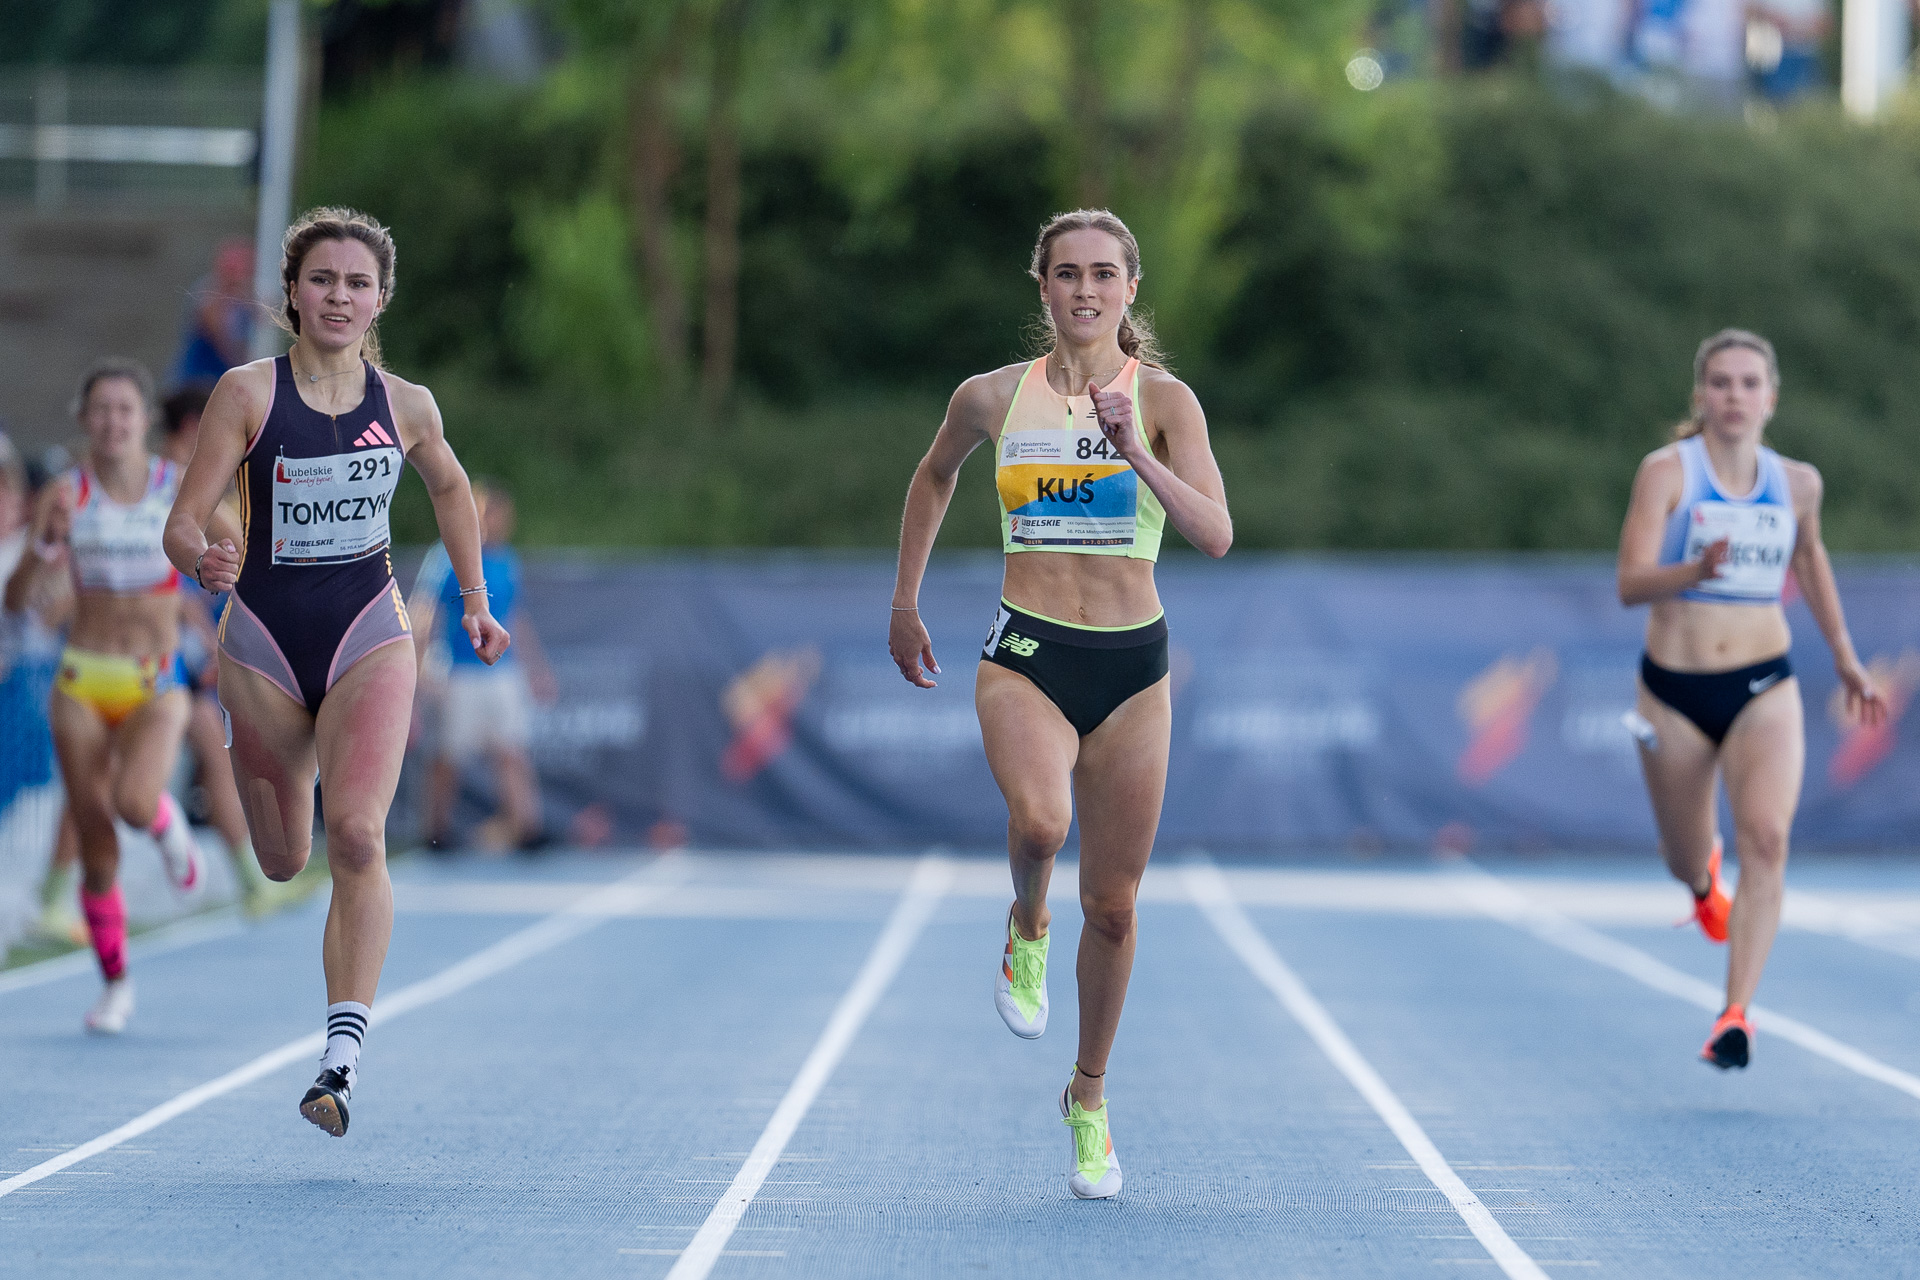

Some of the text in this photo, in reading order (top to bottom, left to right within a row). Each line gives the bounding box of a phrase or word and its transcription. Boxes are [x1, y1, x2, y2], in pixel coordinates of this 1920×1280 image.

[348, 455, 391, 481] 291
[1037, 472, 1095, 504] KUŚ
[278, 488, 392, 526] TOMCZYK
[290, 538, 335, 547] LUBELSKIE
[290, 547, 311, 555] 2024
